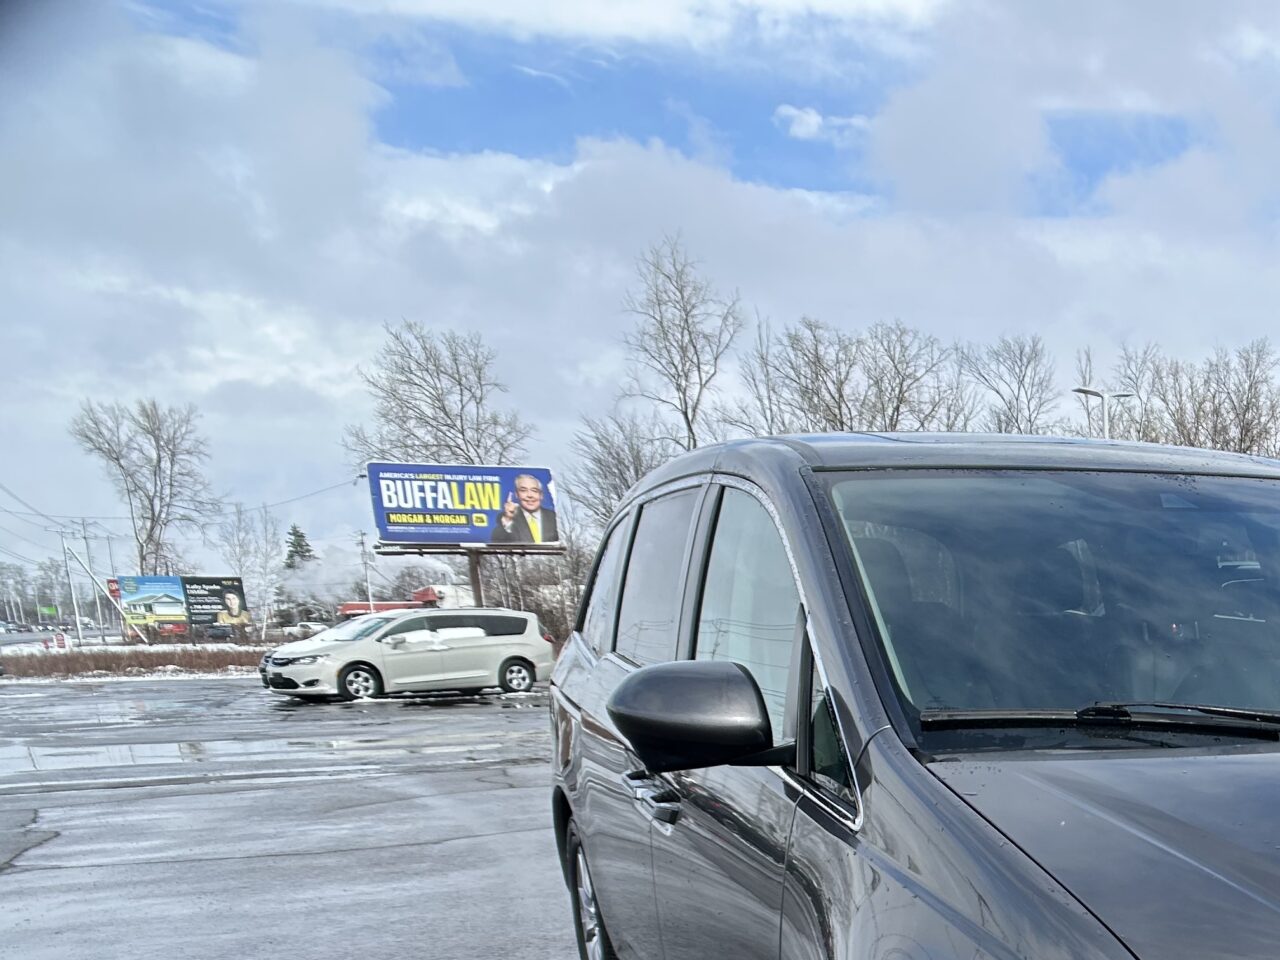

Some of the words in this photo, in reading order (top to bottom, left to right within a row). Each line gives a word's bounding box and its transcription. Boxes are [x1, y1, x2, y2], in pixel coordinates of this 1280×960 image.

[379, 479, 501, 510] BUFFALAW
[389, 513, 424, 524] MORGAN
[426, 514, 432, 524] &
[433, 514, 467, 525] MORGAN
